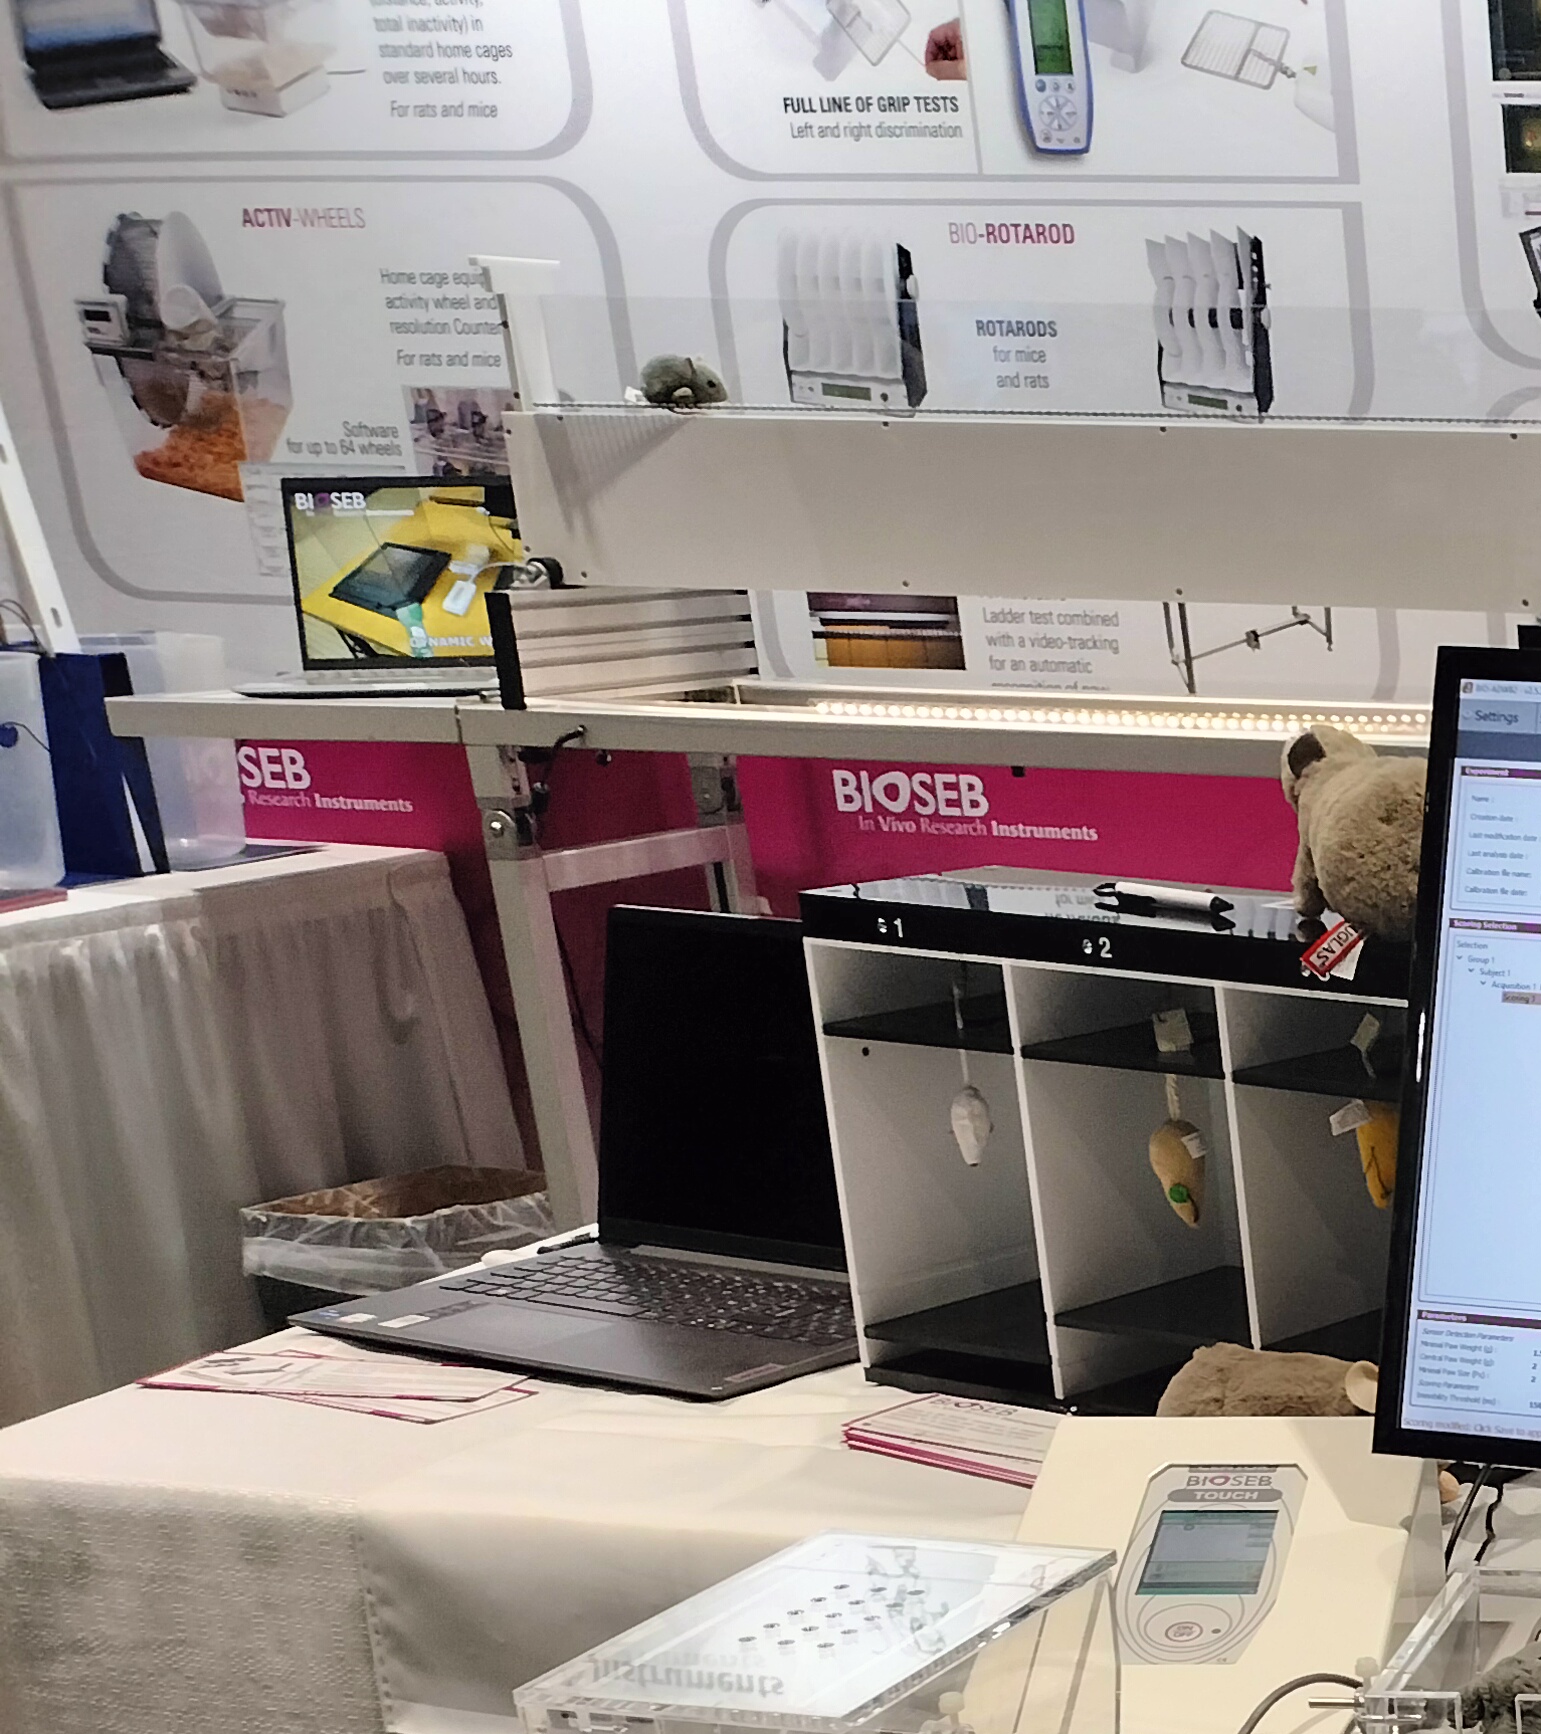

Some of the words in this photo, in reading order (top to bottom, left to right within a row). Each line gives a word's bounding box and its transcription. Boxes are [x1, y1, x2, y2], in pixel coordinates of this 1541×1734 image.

[390, 101, 411, 117] For
[413, 102, 438, 117] rats
[441, 101, 464, 118] and
[468, 102, 499, 118] mice
[783, 97, 818, 114] FULL
[820, 96, 852, 113] LINE
[855, 96, 874, 113] OF
[877, 95, 910, 113] GRIP
[913, 95, 959, 114] TESTS
[790, 123, 815, 139] Left
[817, 122, 841, 138] and
[843, 122, 872, 141] right
[242, 208, 367, 229] ACTIV-WHEELS
[948, 222, 1075, 245] BIO-ROTAROD
[975, 320, 1057, 337] ROTARODS
[294, 492, 366, 510] BIOSEB
[982, 607, 1026, 624] Ladder
[1029, 609, 1053, 625] test
[1057, 610, 1120, 628] combined
[1474, 710, 1519, 725] Settings
[237, 746, 311, 790] SEB
[248, 790, 312, 808] Research
[314, 793, 414, 813] Instruments
[832, 769, 989, 817] BIOSEB
[858, 816, 875, 831] In
[877, 816, 917, 834] Vivo
[920, 818, 988, 836] Research
[991, 820, 1099, 841] Instruments
[1098, 937, 1113, 959] 2
[1316, 924, 1359, 965] UGLAS
[1186, 1475, 1272, 1487] BIOSEB
[1194, 1491, 1259, 1500] TOUCH
